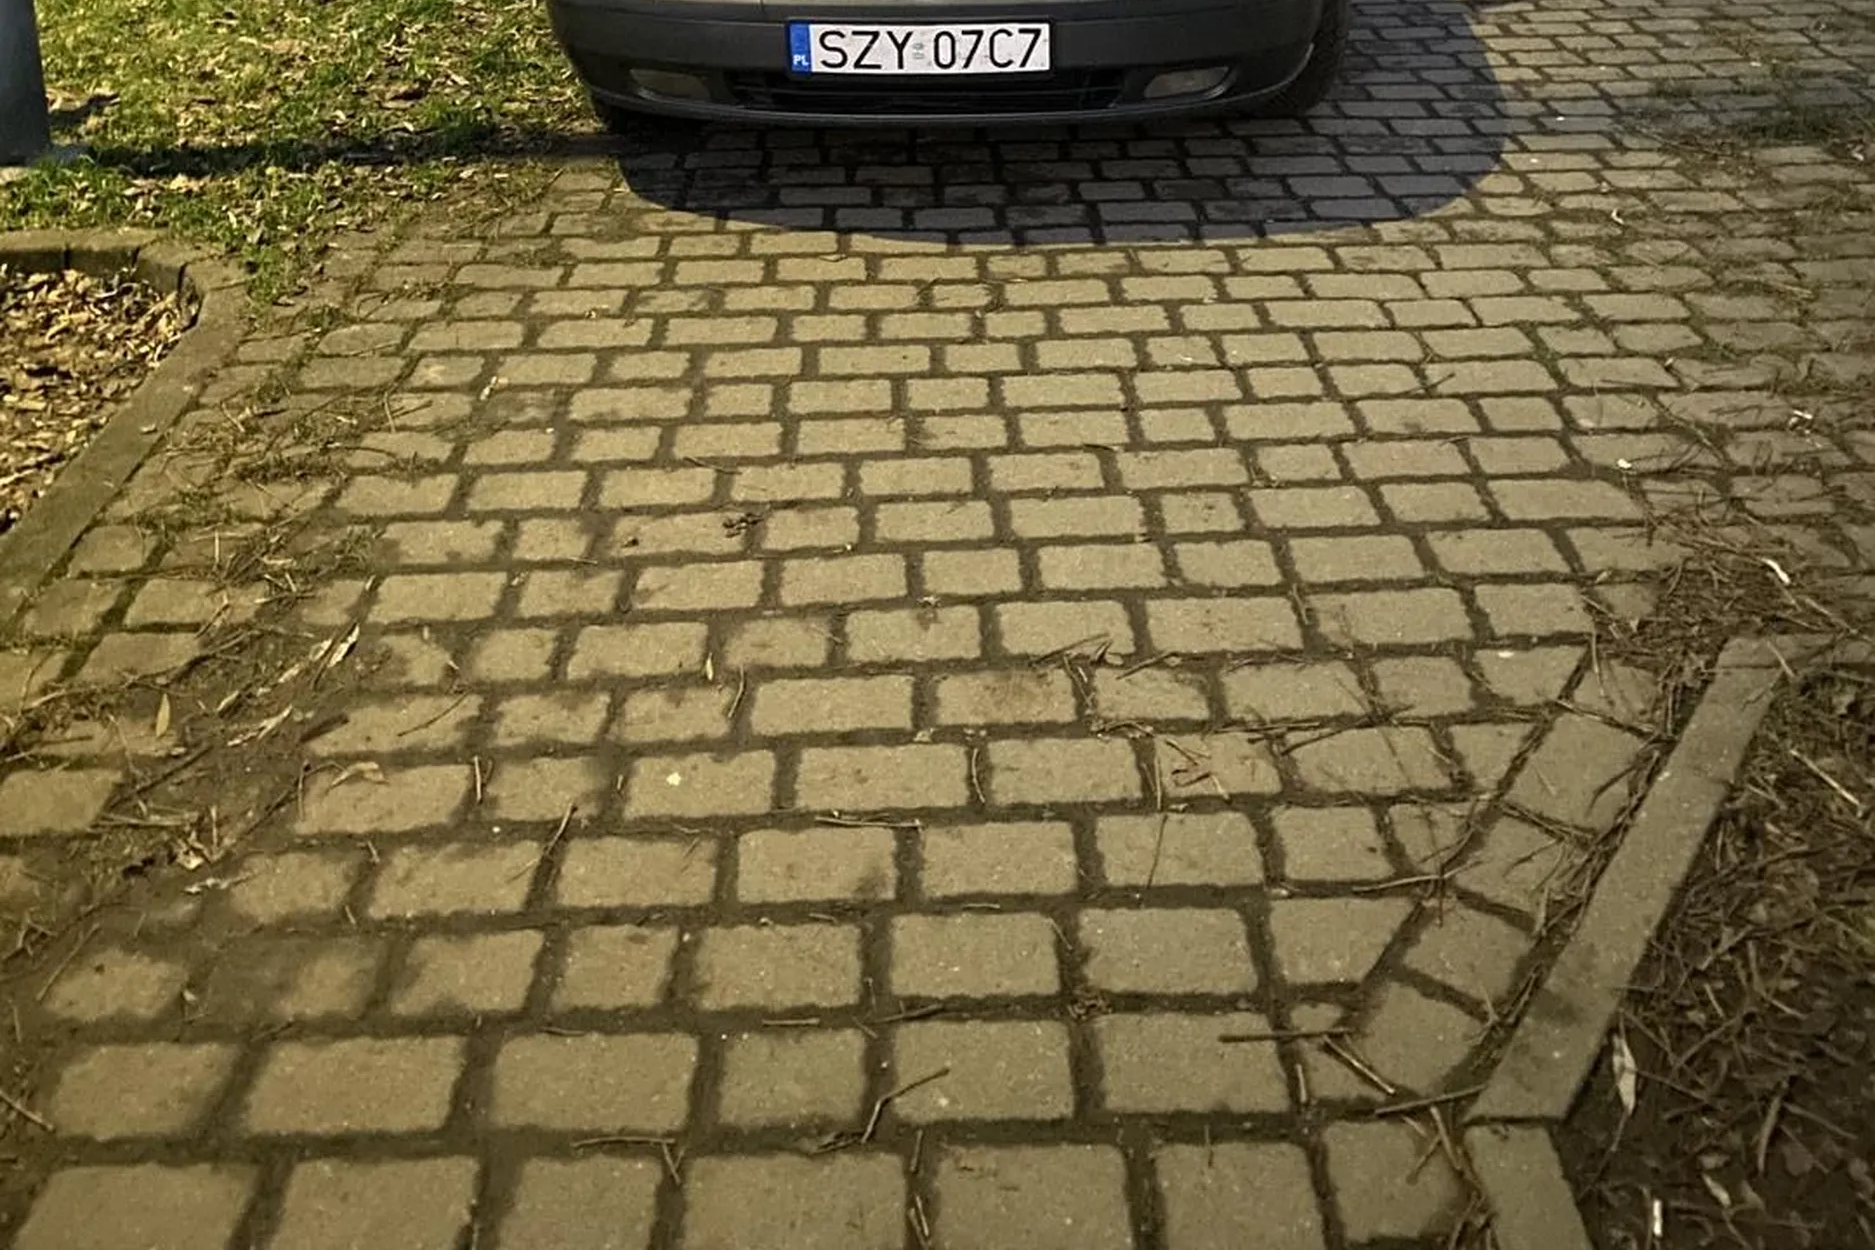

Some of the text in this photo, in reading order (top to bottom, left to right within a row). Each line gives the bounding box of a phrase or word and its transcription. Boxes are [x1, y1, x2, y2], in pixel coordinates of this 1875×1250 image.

[793, 54, 809, 66] PL
[818, 28, 1042, 70] SZY 07C7
